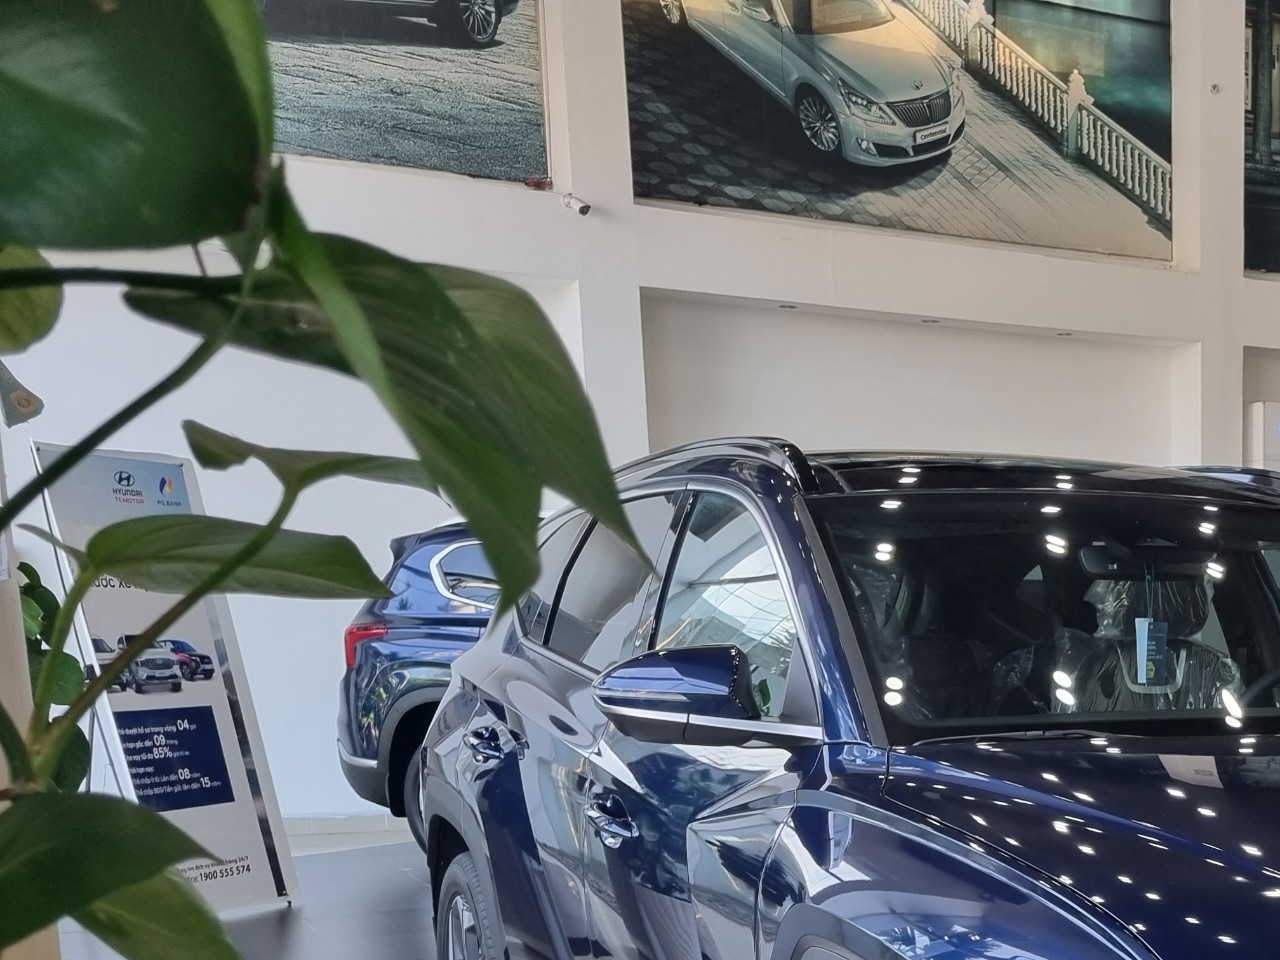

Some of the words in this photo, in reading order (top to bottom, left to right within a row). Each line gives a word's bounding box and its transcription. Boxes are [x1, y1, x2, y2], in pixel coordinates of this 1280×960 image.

[112, 487, 144, 498] HYUNDAI
[176, 718, 190, 731] 04
[153, 734, 166, 746] 09
[153, 746, 173, 760] 85%
[177, 767, 191, 780] 08
[200, 776, 211, 788] 15
[199, 870, 218, 882] 1900
[219, 866, 235, 878] 555
[235, 863, 251, 876] 574
